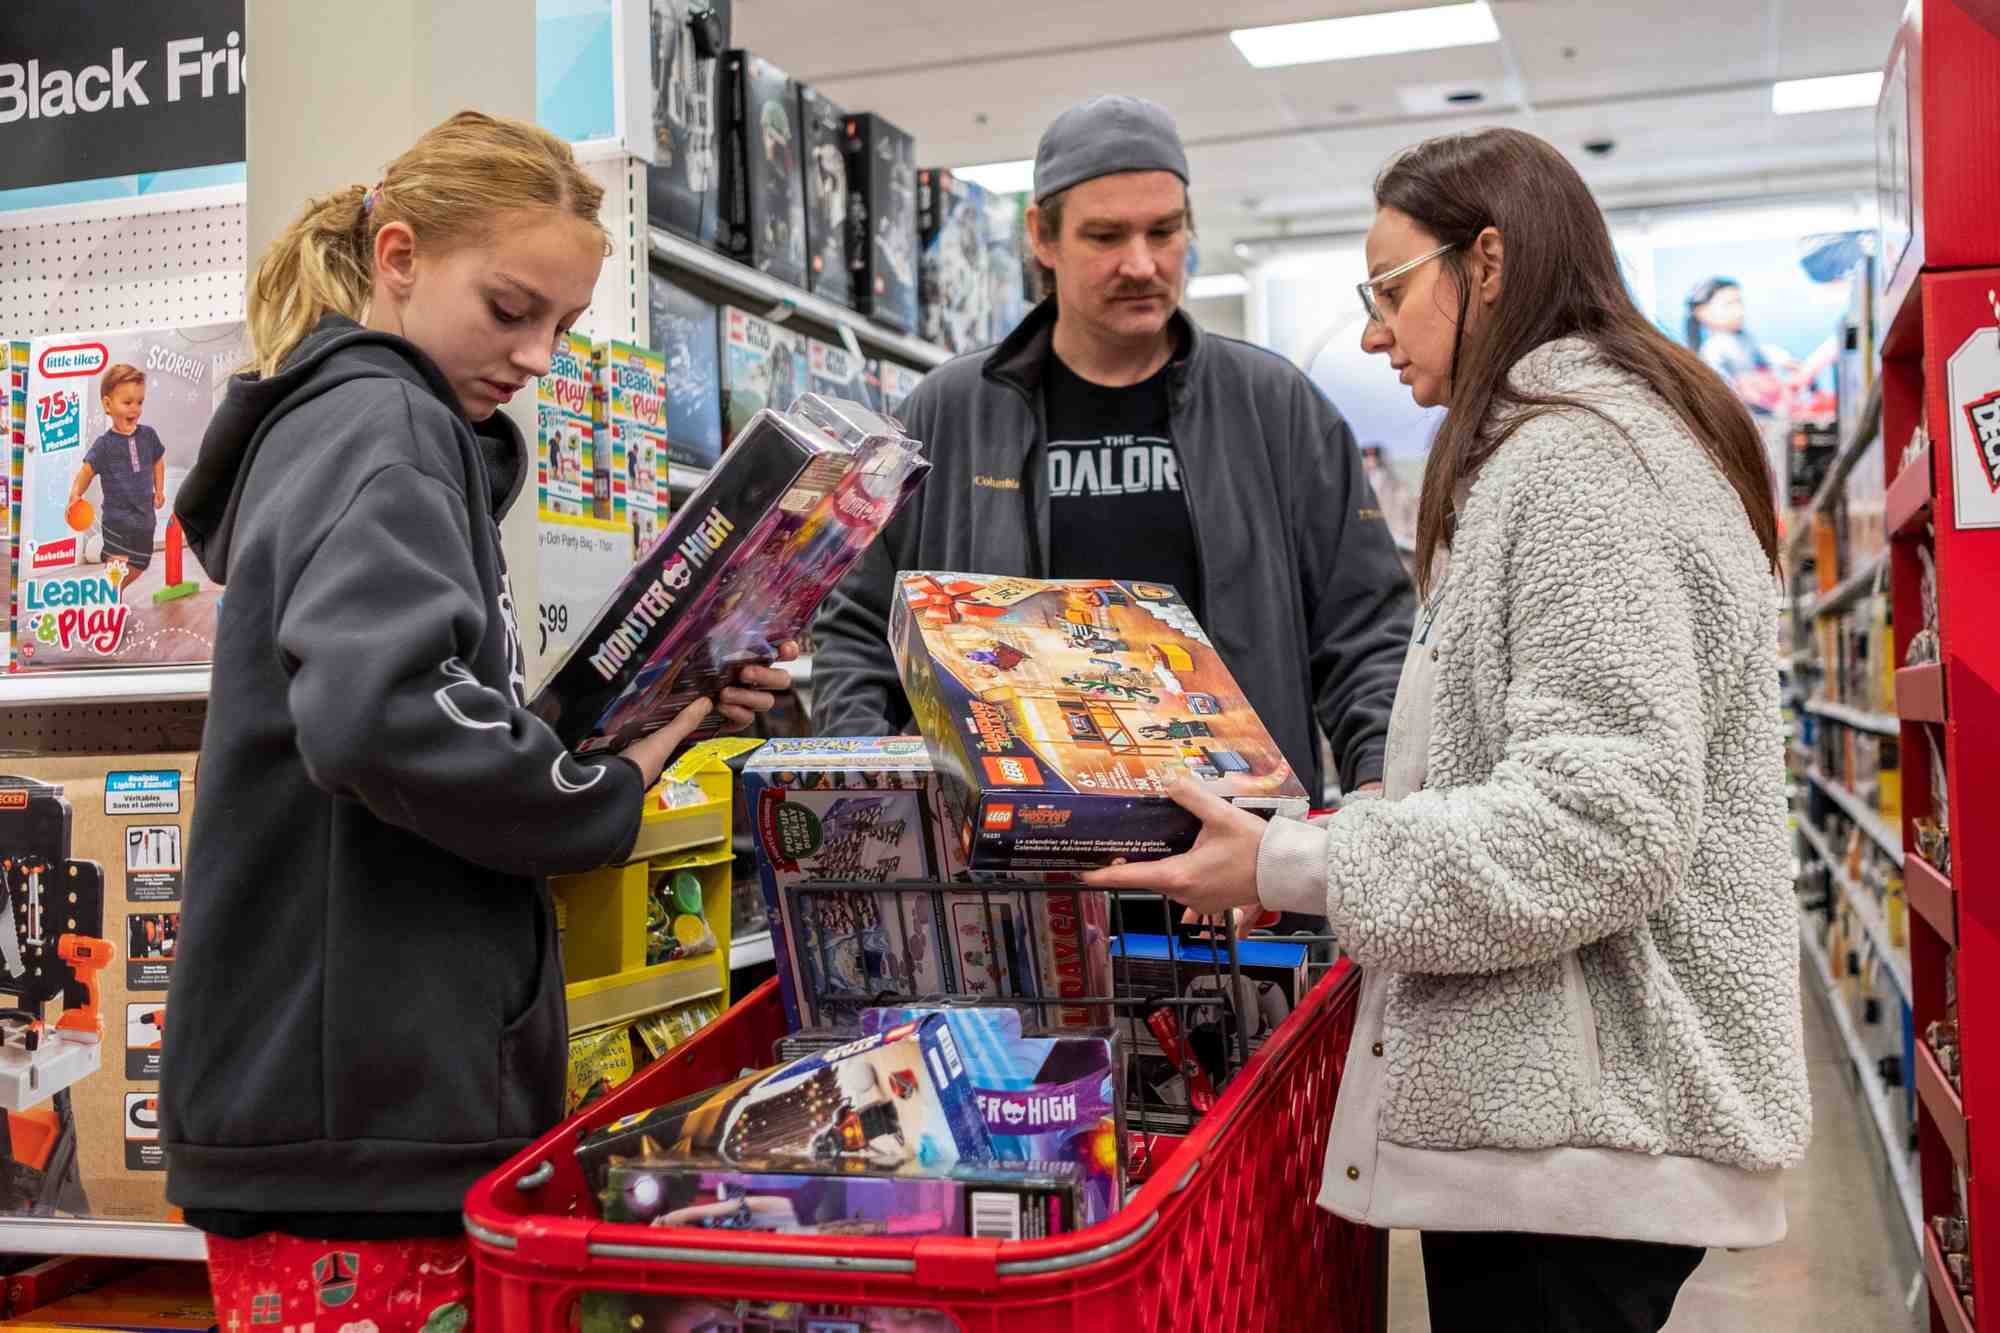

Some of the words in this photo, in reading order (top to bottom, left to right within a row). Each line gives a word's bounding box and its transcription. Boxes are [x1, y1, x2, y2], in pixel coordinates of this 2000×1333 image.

[0, 47, 150, 123] Black
[166, 29, 246, 102] Fri
[47, 353, 72, 369] little
[73, 351, 101, 366] tikes
[556, 377, 586, 414] Play
[632, 393, 660, 426] Play
[1103, 434, 1135, 446] THE
[975, 475, 1020, 489] Columbia
[588, 579, 677, 682] MONSTER
[677, 505, 736, 570] HIGH
[57, 605, 127, 655] Play
[986, 812, 1010, 823] LEGO
[1028, 1094, 1077, 1126] HIGH
